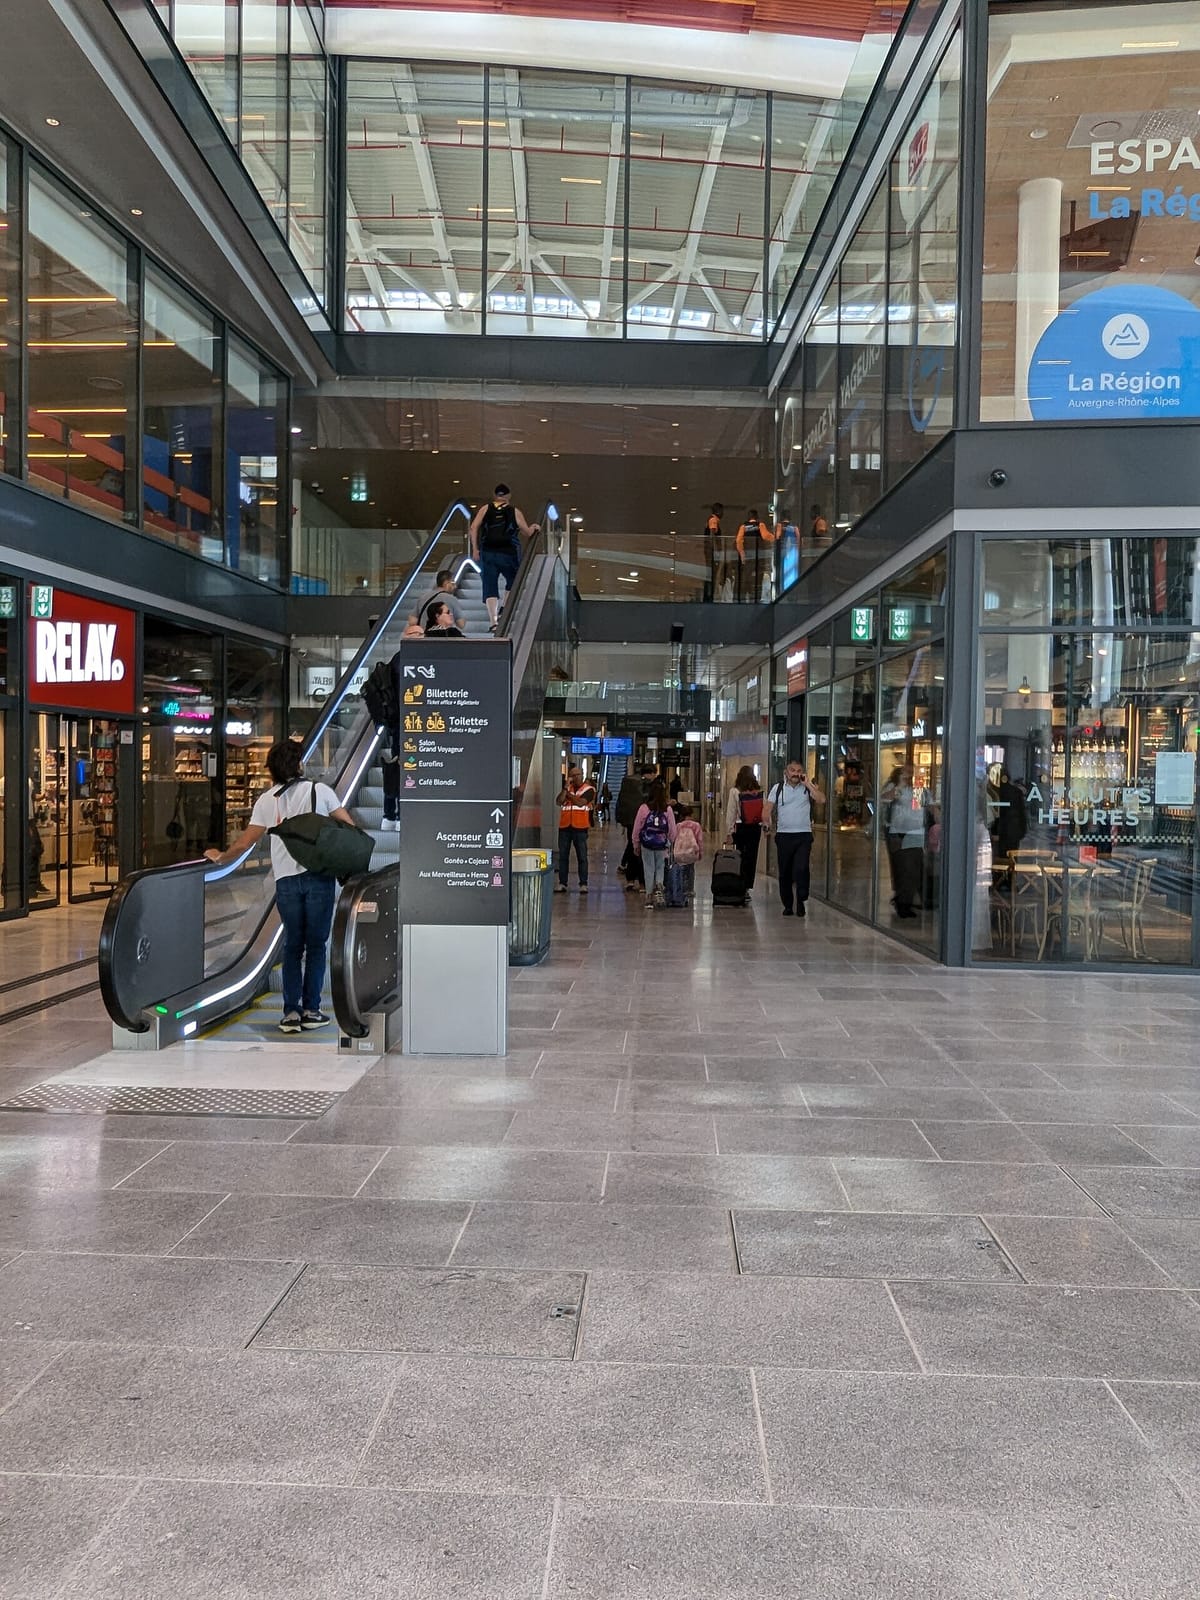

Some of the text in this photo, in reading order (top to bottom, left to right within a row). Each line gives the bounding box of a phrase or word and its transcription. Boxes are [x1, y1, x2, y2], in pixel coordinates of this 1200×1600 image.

[1090, 136, 1200, 175] ESPA
[1088, 190, 1130, 220] La
[1068, 371, 1181, 393] La Région
[1068, 396, 1180, 409] Auvergne-Rhône-Alpes
[426, 689, 469, 698] Billetterie
[449, 716, 489, 726] Toilettes
[437, 746, 464, 754] Voyageur
[418, 760, 444, 768] Eurofins
[418, 778, 457, 786] Café Blondie
[1026, 782, 1151, 804] À TOUTES
[1038, 808, 1139, 827] HEURES
[436, 831, 482, 841] Ascenseur
[468, 857, 489, 866] Cojean
[447, 879, 489, 888] Carrefour City
